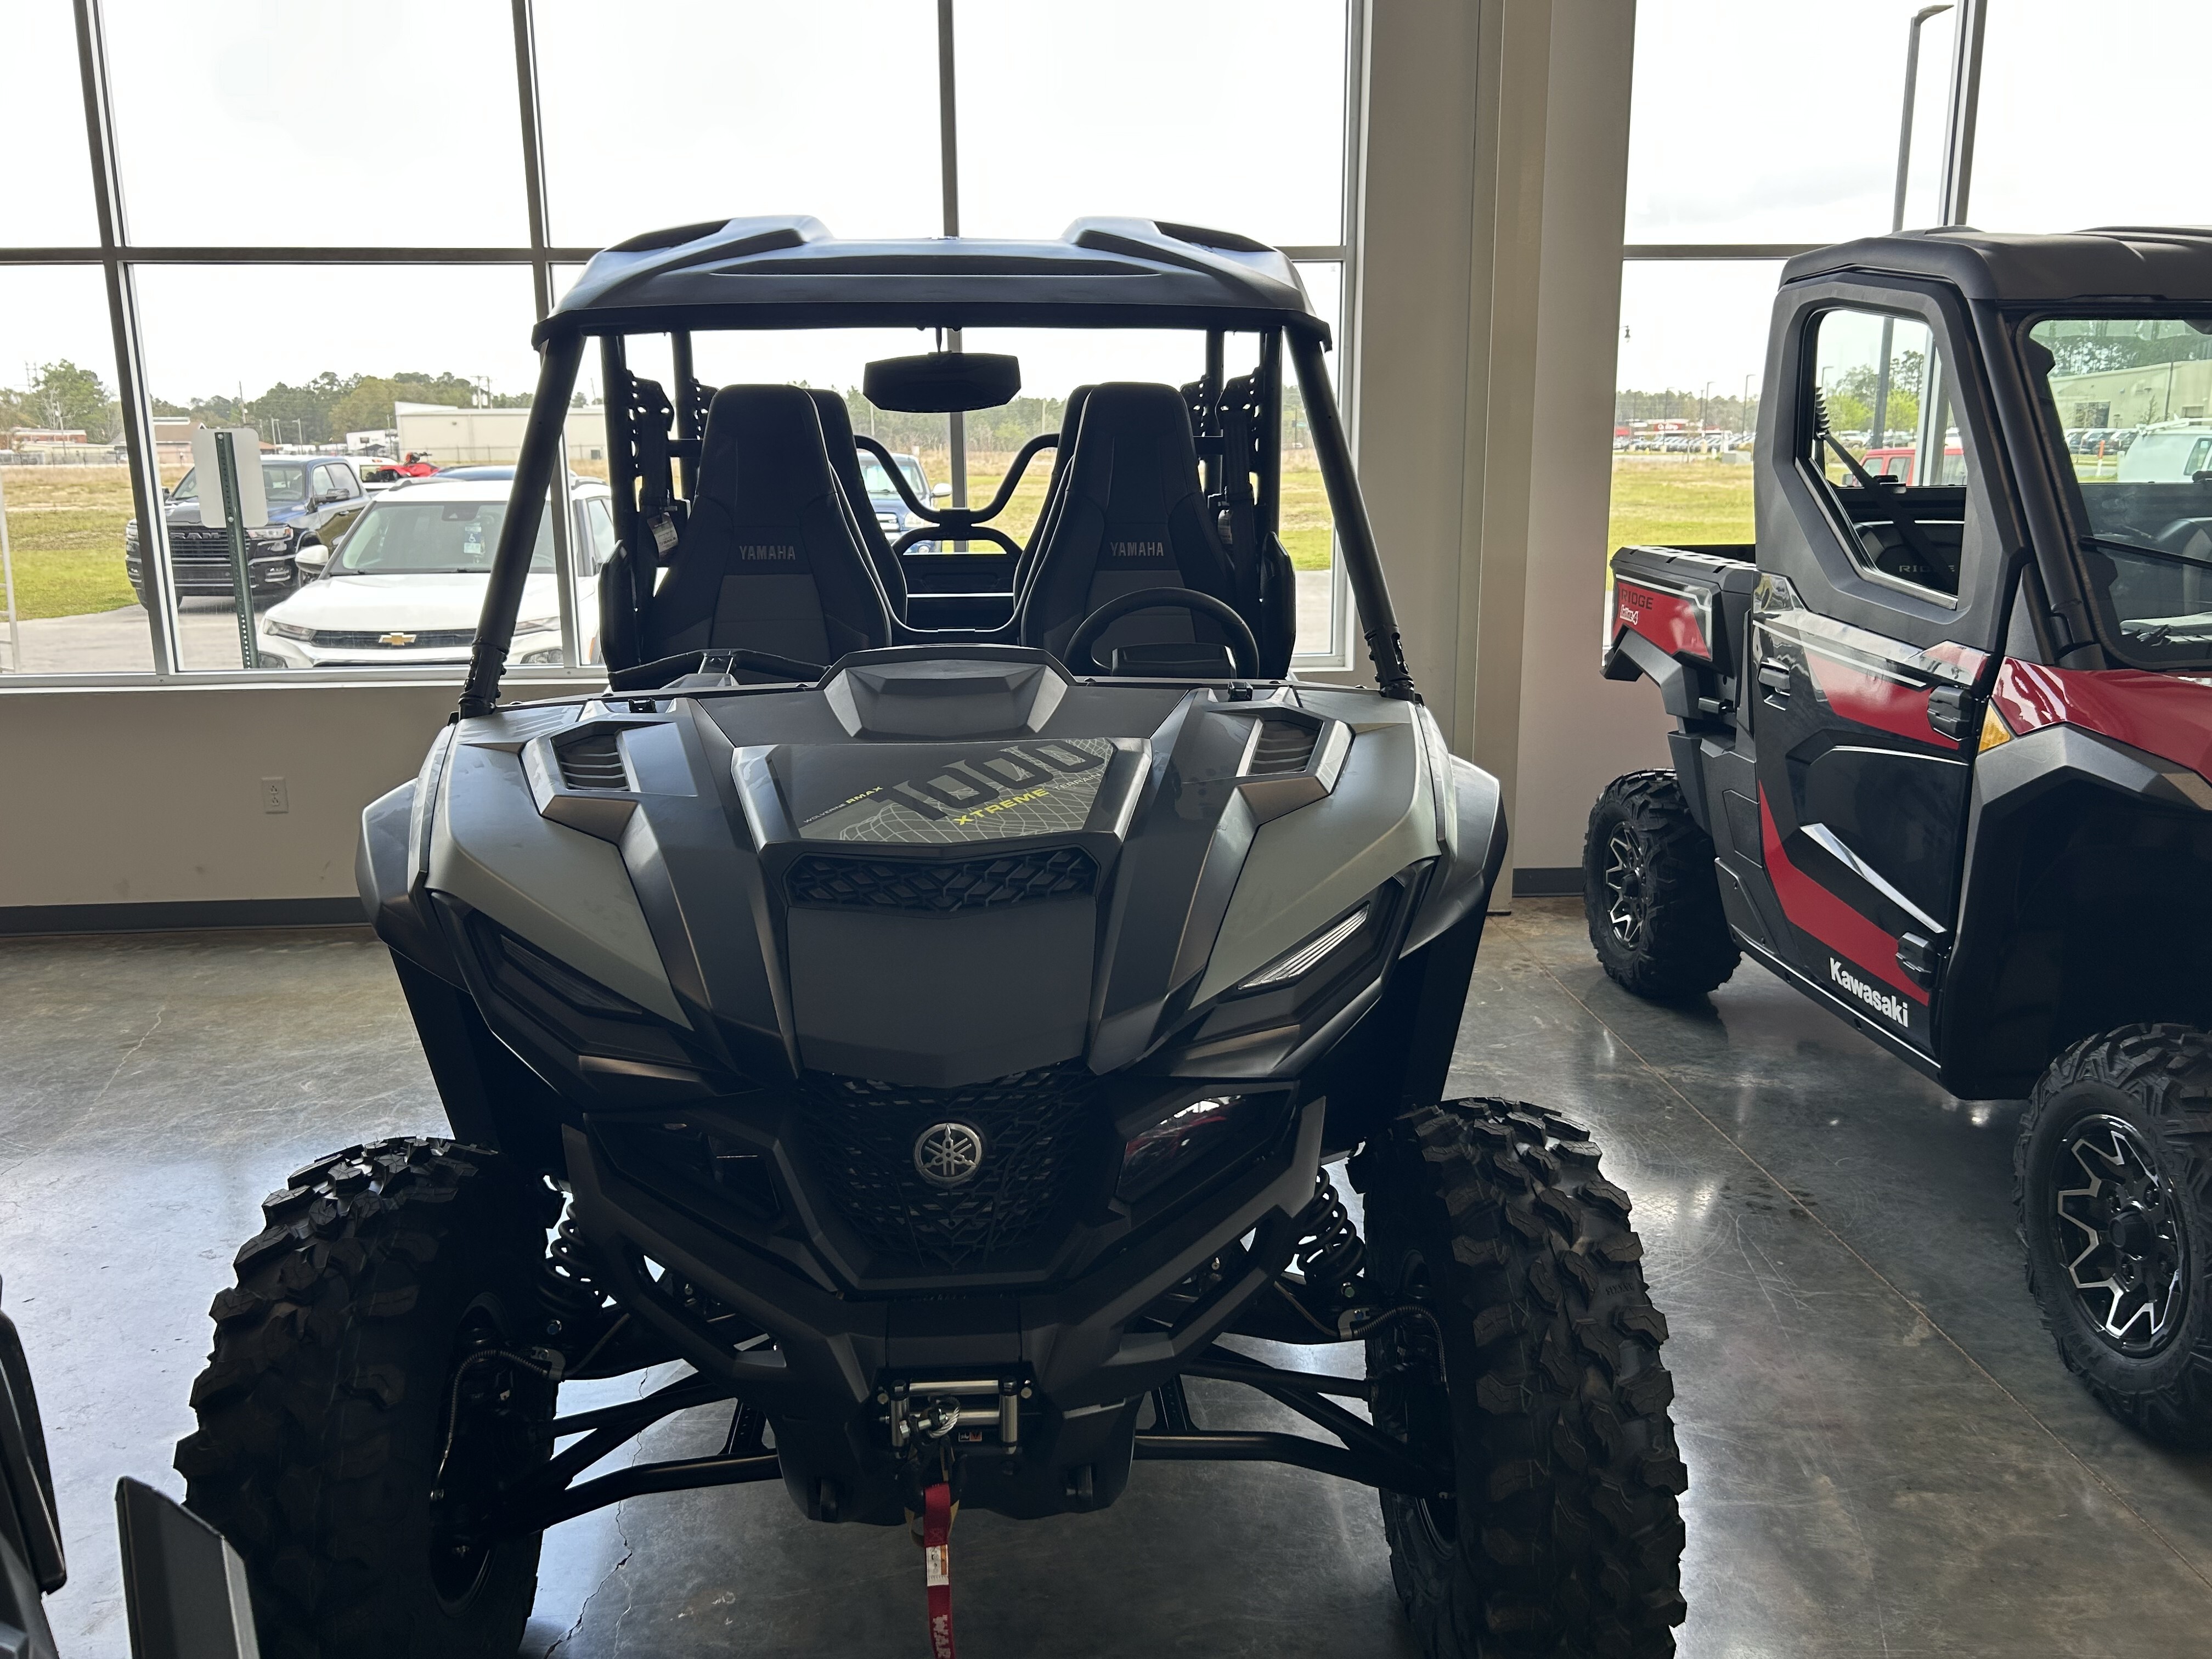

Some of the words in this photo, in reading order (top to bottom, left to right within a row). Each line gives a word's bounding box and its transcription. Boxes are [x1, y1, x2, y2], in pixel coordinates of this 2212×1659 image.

[739, 545, 795, 560] YAMAHA
[1110, 541, 1164, 556] YAMAHA
[1621, 589, 1654, 610] RIDGE
[874, 741, 1105, 821] 1000
[952, 788, 1049, 825] XTREME
[1053, 773, 1102, 785] TERRAIN
[803, 803, 847, 823] WOLVERINE
[845, 786, 883, 804] RMAX
[1830, 957, 1909, 1028] Kawasaki
